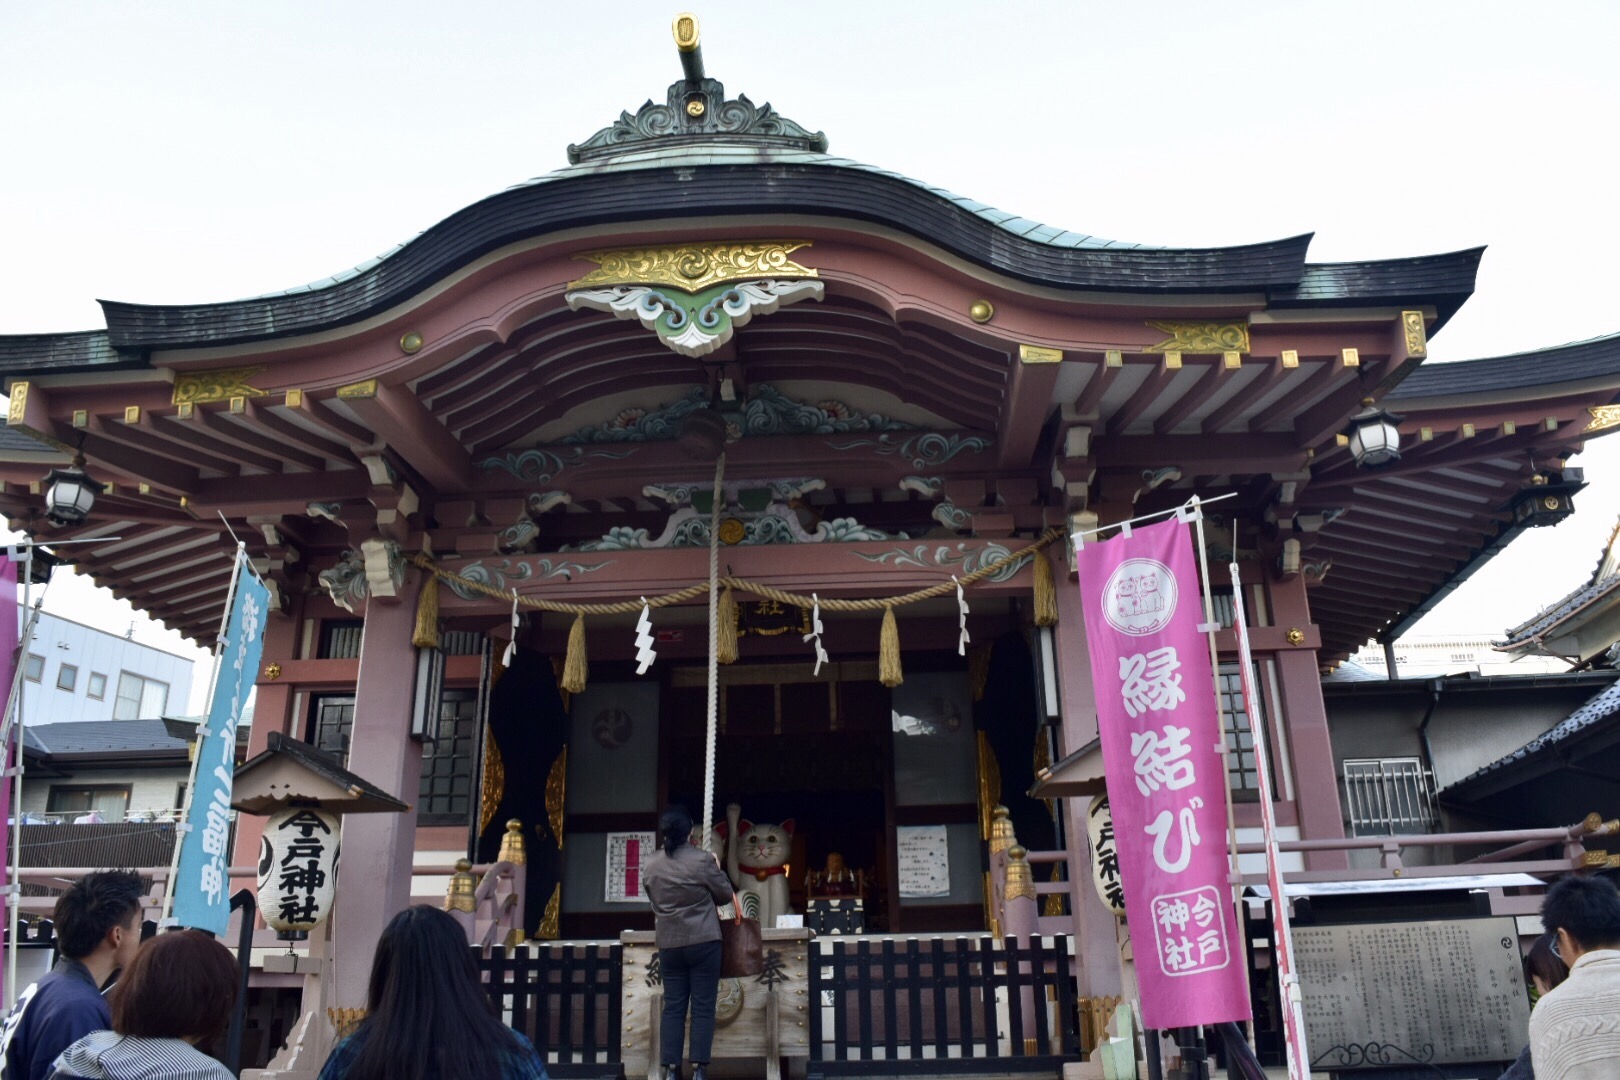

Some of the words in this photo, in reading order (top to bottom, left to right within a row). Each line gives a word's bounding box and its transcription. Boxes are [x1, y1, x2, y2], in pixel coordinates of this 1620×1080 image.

[755, 600, 785, 615] 社
[1118, 646, 1204, 874] 縁結び
[279, 810, 331, 924] 今戸神社
[1158, 899, 1198, 972] 神社
[1191, 894, 1221, 967] 今戸
[754, 948, 790, 992] 奉
[1506, 952, 1520, 998] 今戸神社
